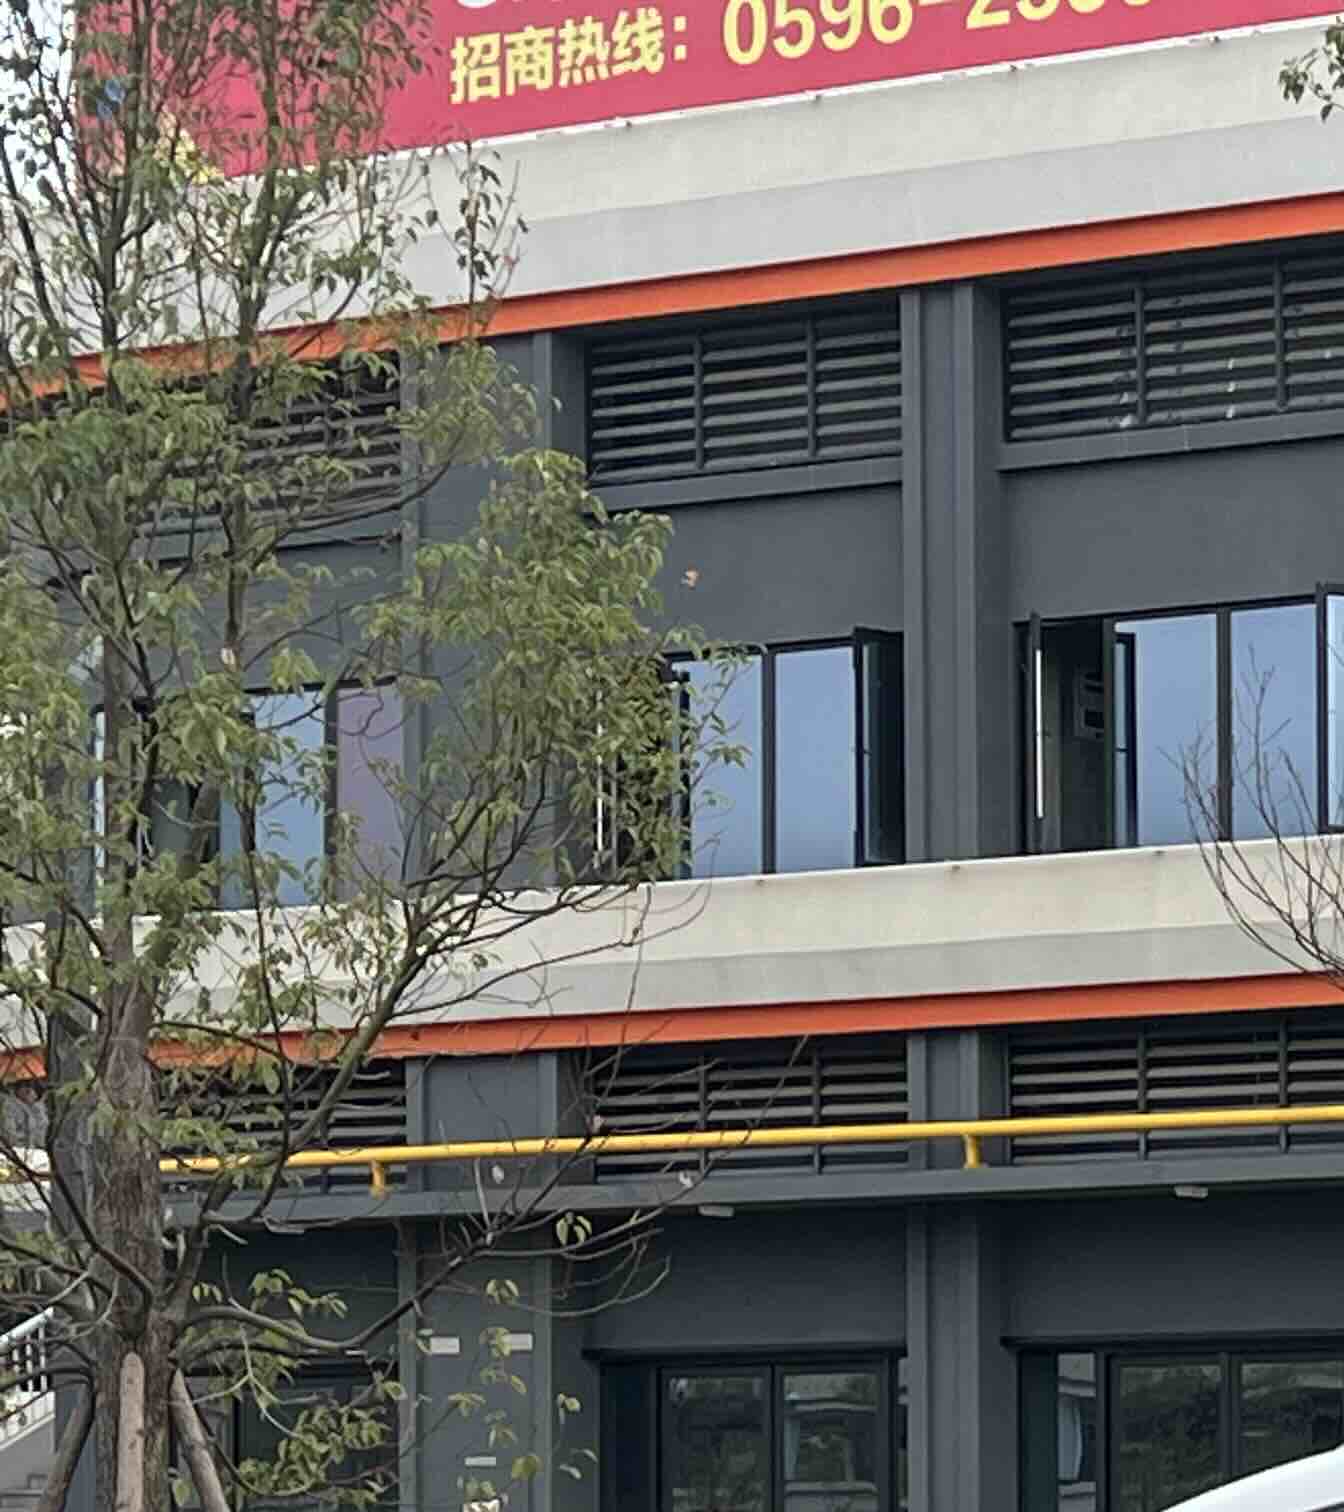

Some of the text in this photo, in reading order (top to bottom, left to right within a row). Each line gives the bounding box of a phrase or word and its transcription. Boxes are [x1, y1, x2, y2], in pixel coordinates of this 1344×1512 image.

[450, 0, 1152, 104] 招商热线： 0596-
